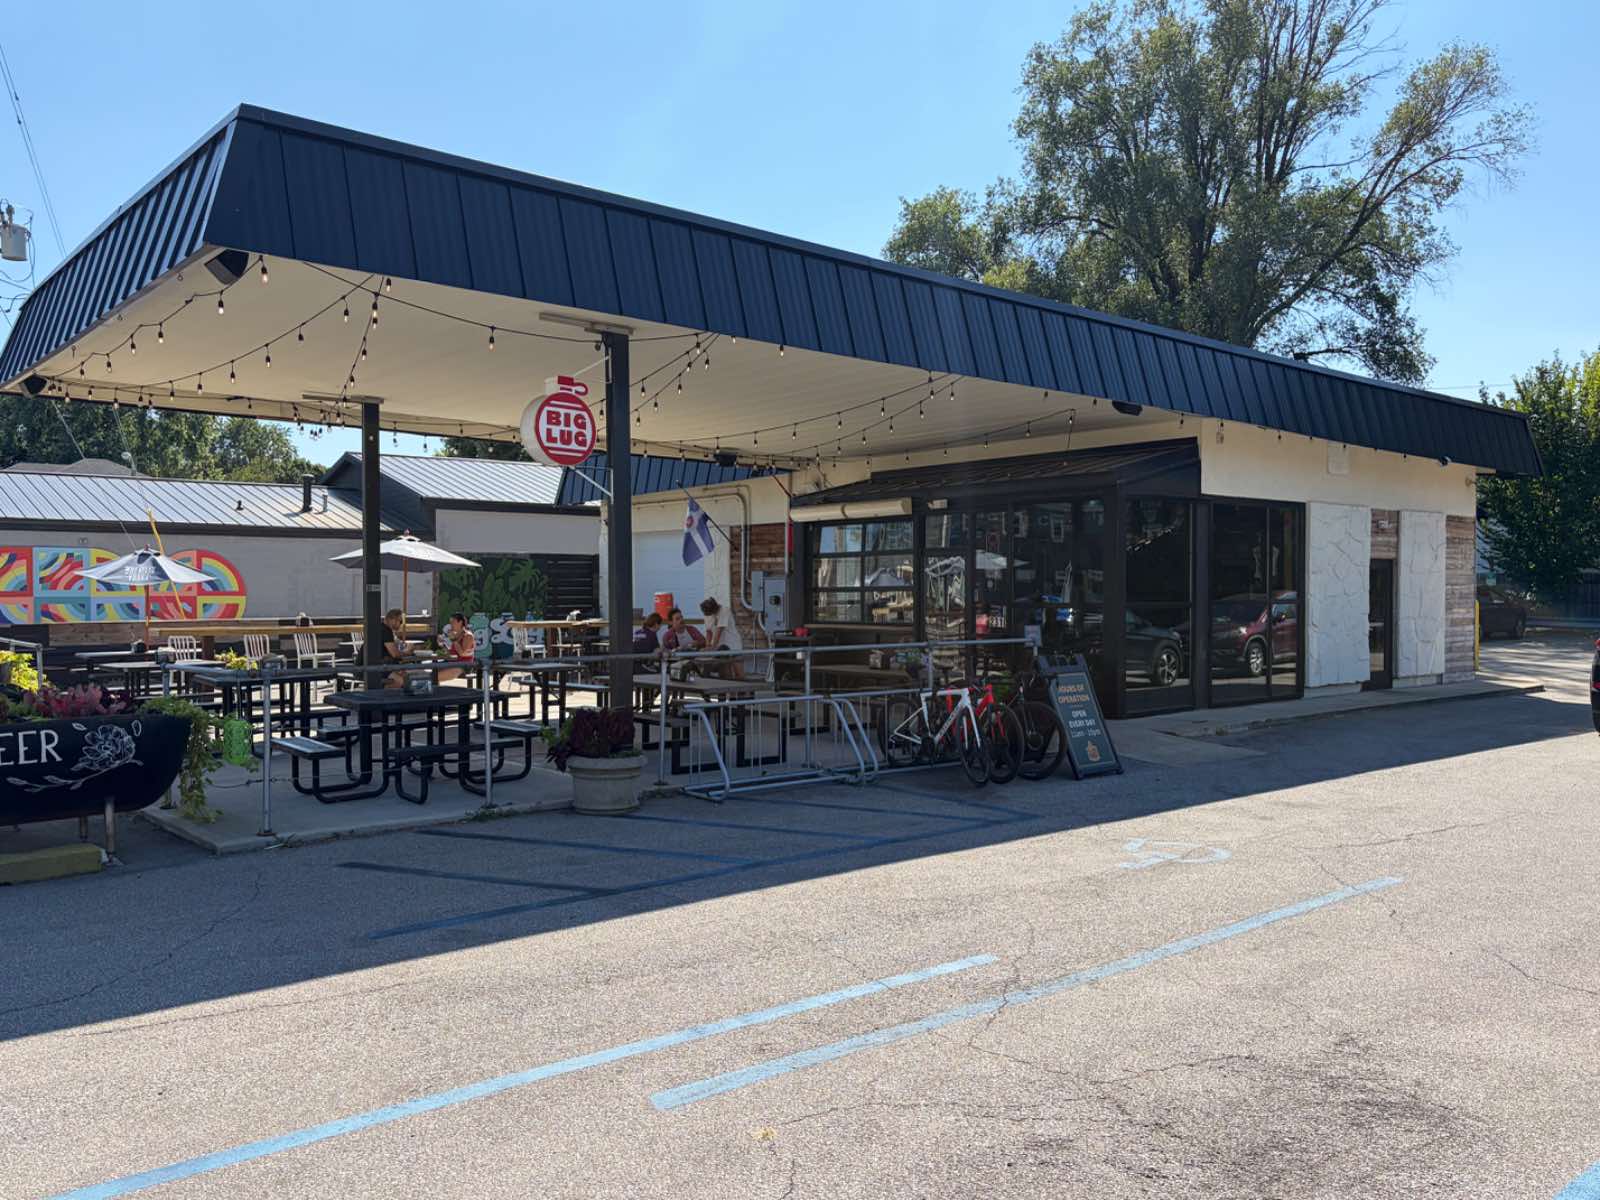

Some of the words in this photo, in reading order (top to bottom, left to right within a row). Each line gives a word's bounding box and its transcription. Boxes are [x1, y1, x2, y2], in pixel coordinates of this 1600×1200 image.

[547, 410, 587, 430] BIG
[546, 428, 587, 447] LUG
[1072, 710, 1087, 718] OPEN
